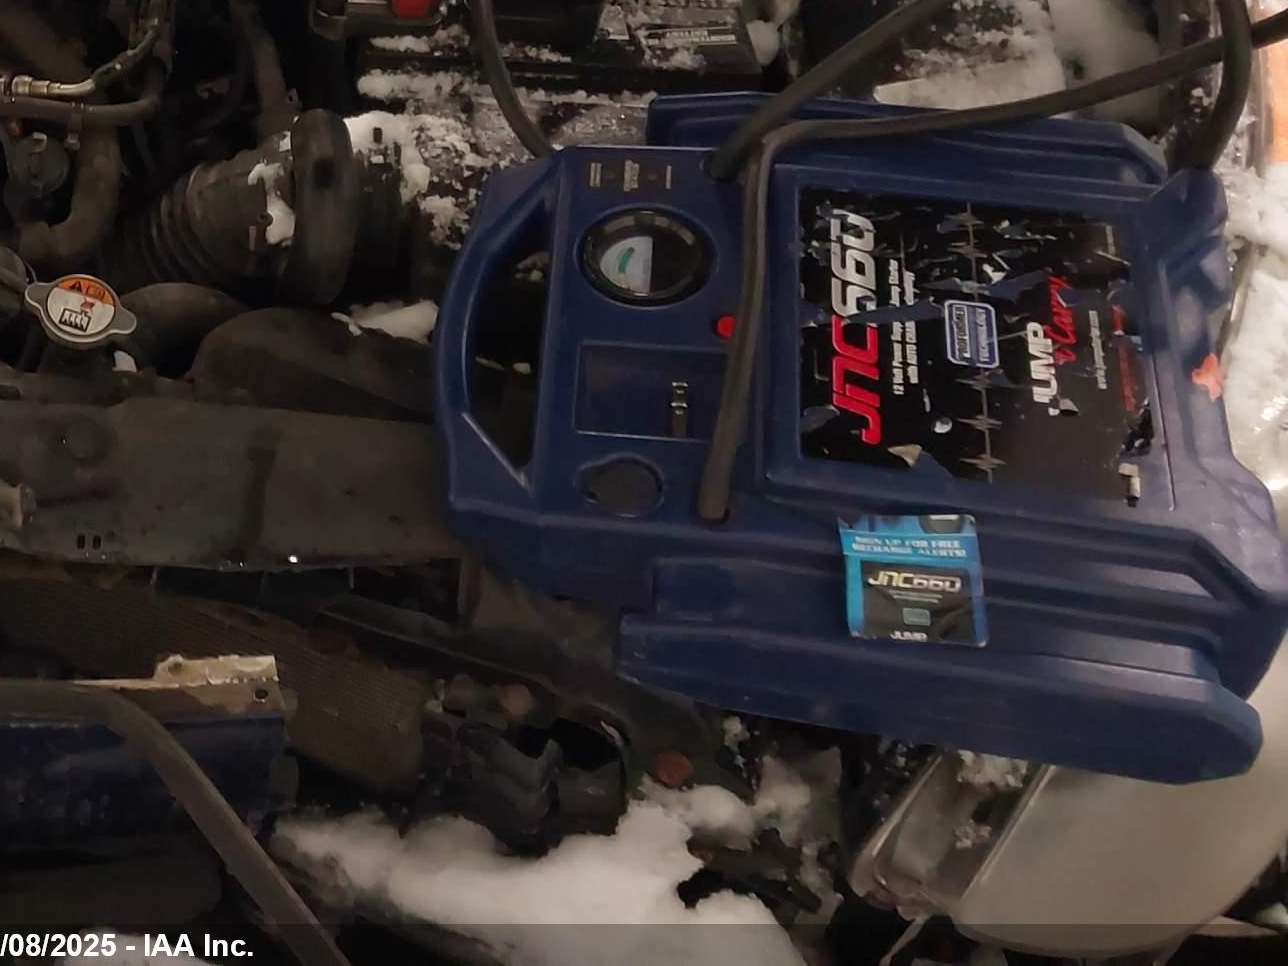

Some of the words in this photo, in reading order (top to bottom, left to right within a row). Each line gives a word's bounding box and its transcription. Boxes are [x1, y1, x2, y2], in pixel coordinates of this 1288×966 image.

[831, 208, 882, 445] JNC660
[905, 539, 929, 548] FOR
[931, 539, 961, 549] FREE
[867, 570, 962, 592] JNC660
[890, 630, 928, 643] JUMP
